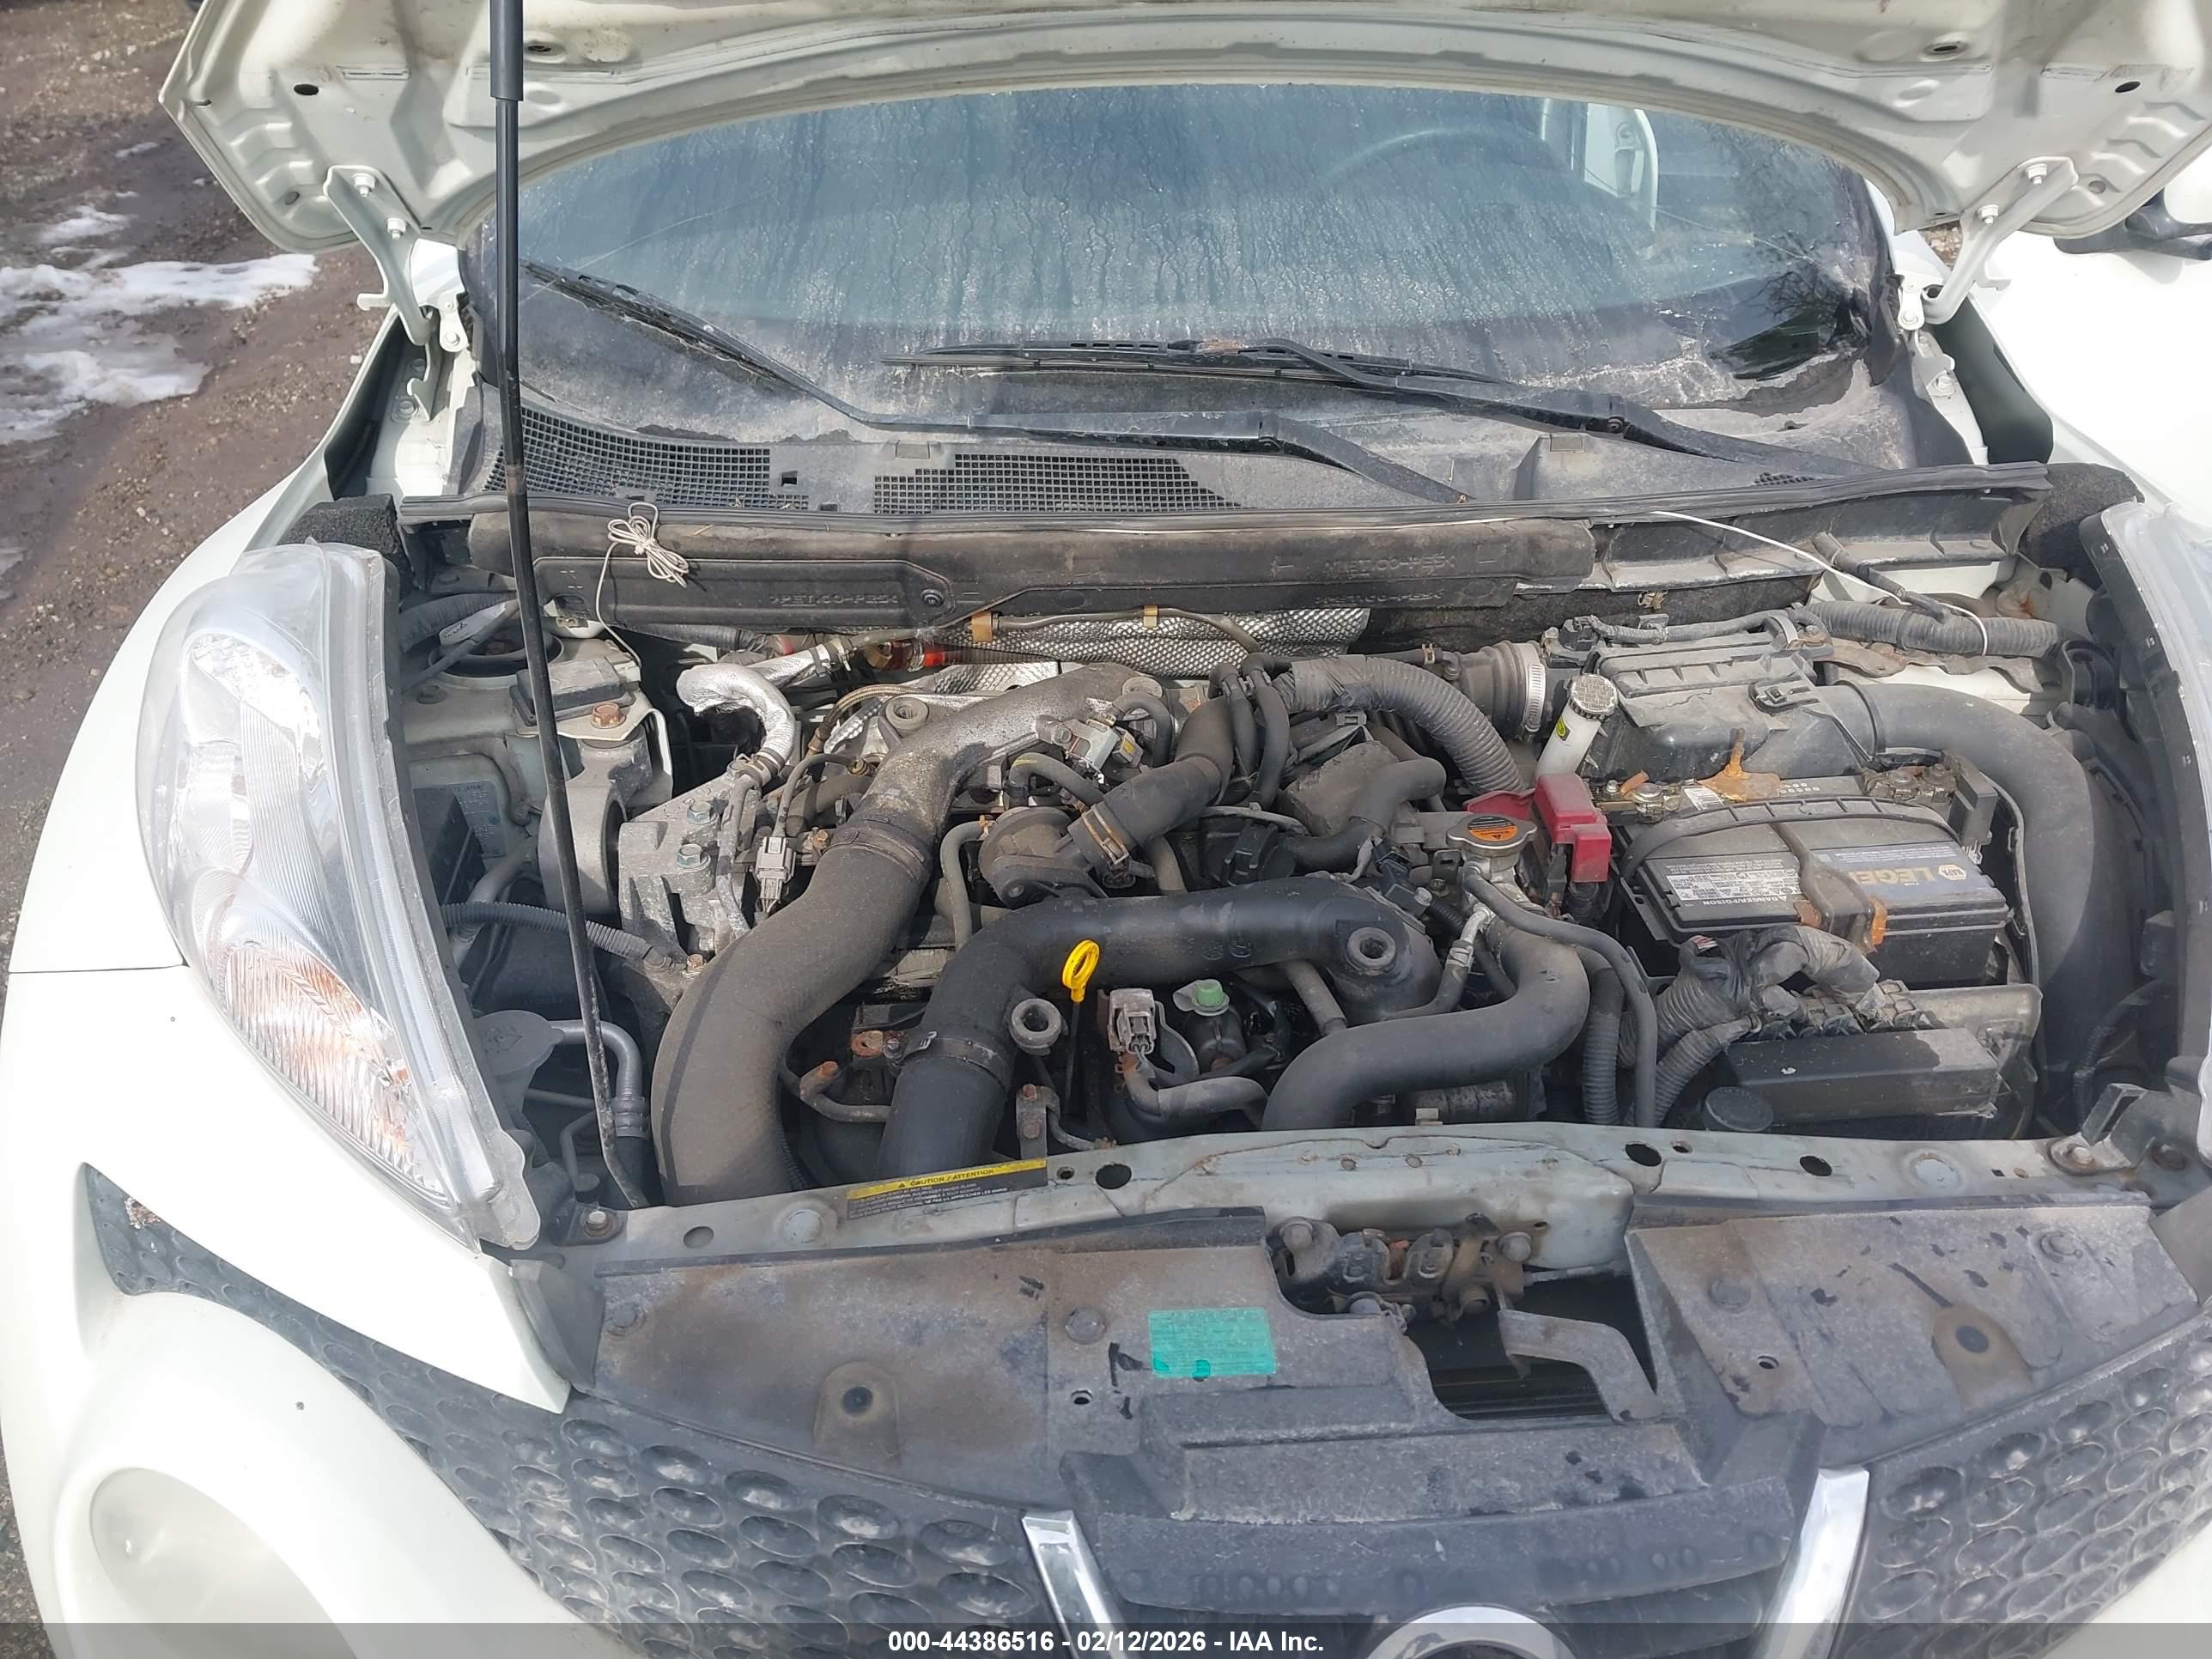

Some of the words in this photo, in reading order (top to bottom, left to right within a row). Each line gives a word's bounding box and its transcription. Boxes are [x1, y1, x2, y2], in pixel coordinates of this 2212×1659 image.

[1940, 867, 1965, 878] NAPA
[910, 1176, 945, 1186] CAUTION
[952, 1169, 994, 1181] ATTENTION
